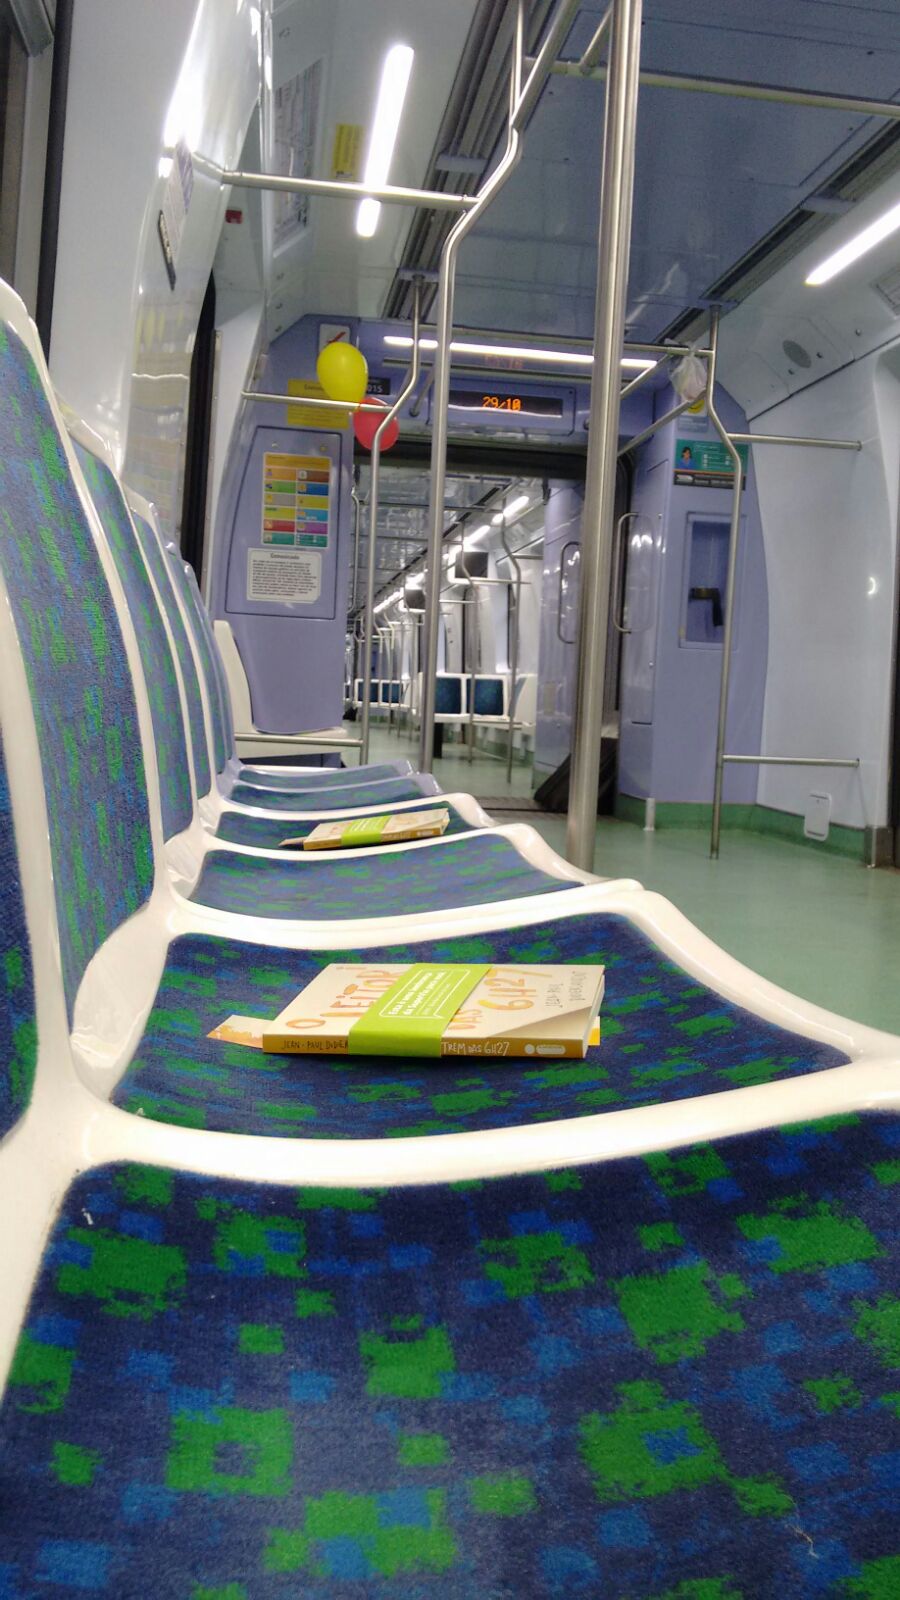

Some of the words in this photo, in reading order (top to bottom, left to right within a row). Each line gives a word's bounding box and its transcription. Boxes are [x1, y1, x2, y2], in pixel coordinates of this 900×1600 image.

[482, 396, 521, 412] 29/10
[478, 967, 552, 1011] 6H27
[285, 1018, 326, 1029] O
[441, 1041, 466, 1056] TREM
[484, 1041, 510, 1056] 6H27
